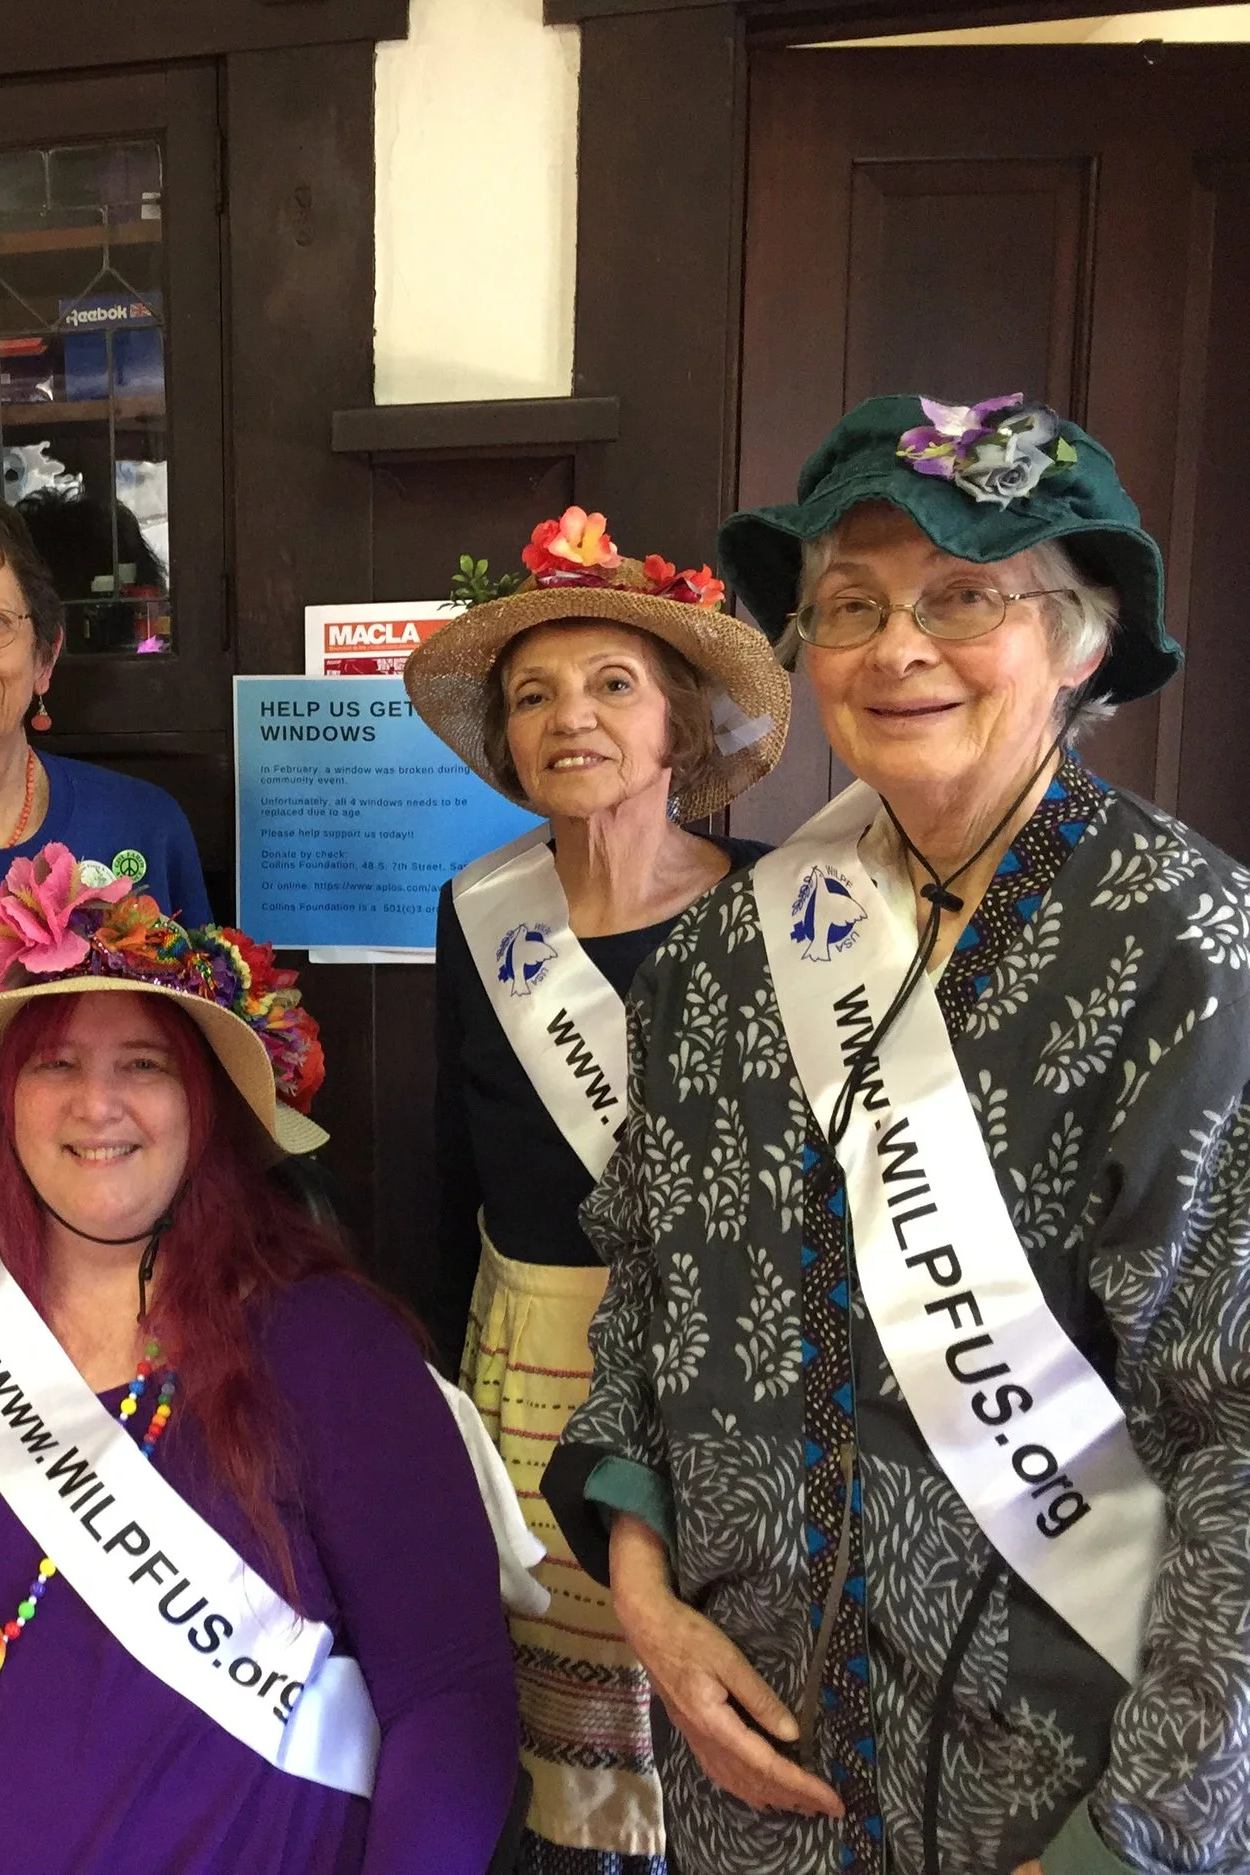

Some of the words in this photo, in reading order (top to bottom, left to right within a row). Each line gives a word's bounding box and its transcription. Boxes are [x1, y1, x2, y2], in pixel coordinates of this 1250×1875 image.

[66, 305, 127, 327] Reebok
[329, 622, 420, 645] MACLA
[260, 701, 320, 717] HELP
[330, 701, 360, 717] US
[370, 701, 413, 717] GET
[260, 725, 376, 741] WINDOWS
[260, 765, 270, 773] In
[334, 765, 372, 774] window
[375, 767, 395, 775] was
[399, 765, 434, 775] broken
[437, 764, 470, 775] during
[260, 777, 313, 785] community
[335, 797, 347, 806] all
[350, 798, 356, 806] 4
[359, 798, 404, 807] windows
[406, 798, 438, 807] needs
[442, 799, 452, 807] to
[455, 798, 468, 806] be
[260, 808, 304, 817] replaced
[307, 808, 326, 816] due
[329, 808, 339, 816] to
[261, 828, 295, 838] Please
[298, 828, 320, 839] help
[323, 829, 361, 839] support
[364, 831, 376, 839] us
[261, 850, 297, 859] Donate
[300, 850, 312, 860] by
[261, 860, 296, 869] Collins
[362, 862, 374, 870] 48
[392, 862, 408, 871] 7th
[825, 864, 854, 889] WILPF
[261, 881, 273, 890] Or
[261, 903, 296, 912] Collins
[299, 903, 355, 913] Foundation
[383, 903, 422, 914] 501(c)3
[425, 905, 438, 914] or
[835, 930, 861, 953] USA
[547, 1008, 628, 1143] www.
[833, 983, 1090, 1541] www.WILPFUS.org
